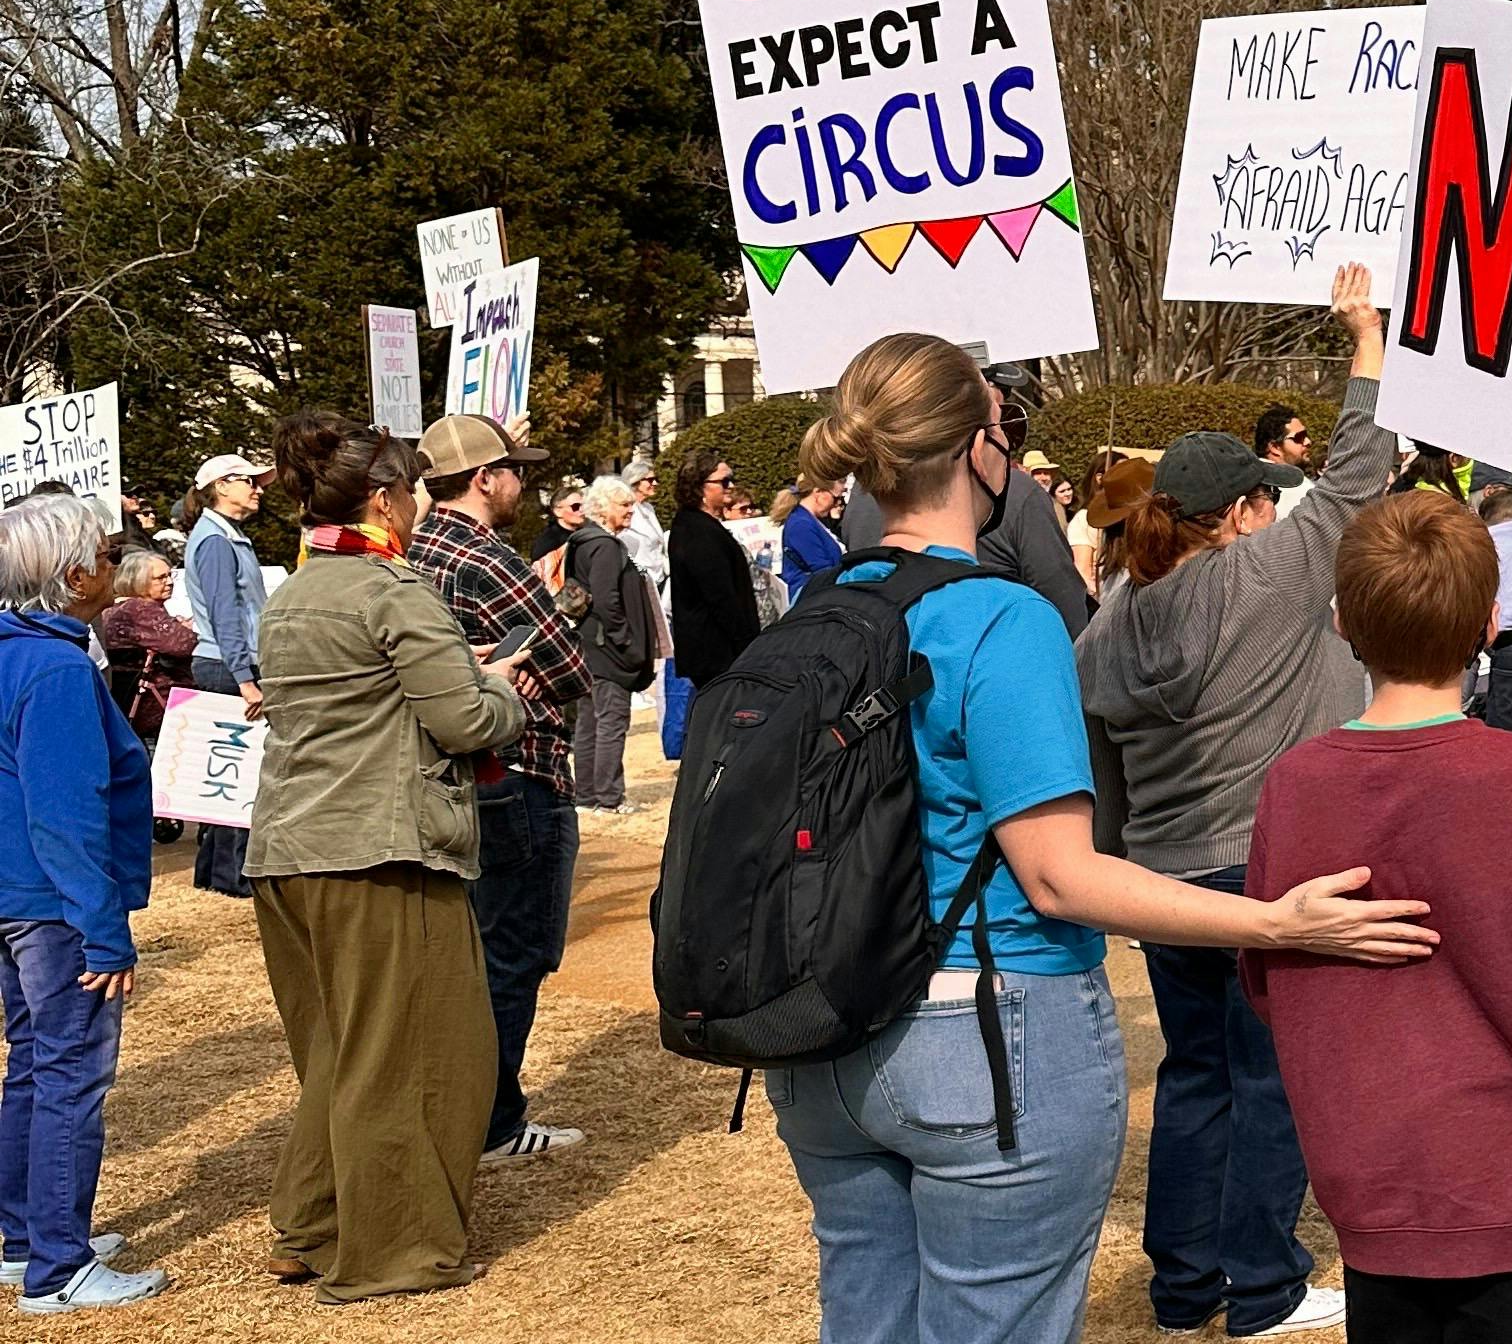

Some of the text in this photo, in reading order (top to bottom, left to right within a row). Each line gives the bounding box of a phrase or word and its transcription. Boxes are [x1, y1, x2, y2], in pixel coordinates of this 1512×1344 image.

[728, 1, 941, 100] EXPECT
[1227, 21, 1418, 100] MAKE RAC
[1223, 163, 1409, 235] AFRAID AGA
[422, 223, 459, 256] NONE
[471, 217, 491, 245] US
[435, 258, 483, 286] WITHOUT
[372, 312, 415, 333] SEPARATE
[384, 358, 405, 372] STATE
[381, 376, 412, 402] NOT
[23, 393, 95, 445] STOP
[0, 436, 108, 477] HE $4 Trillion
[198, 721, 254, 802] MUSK
